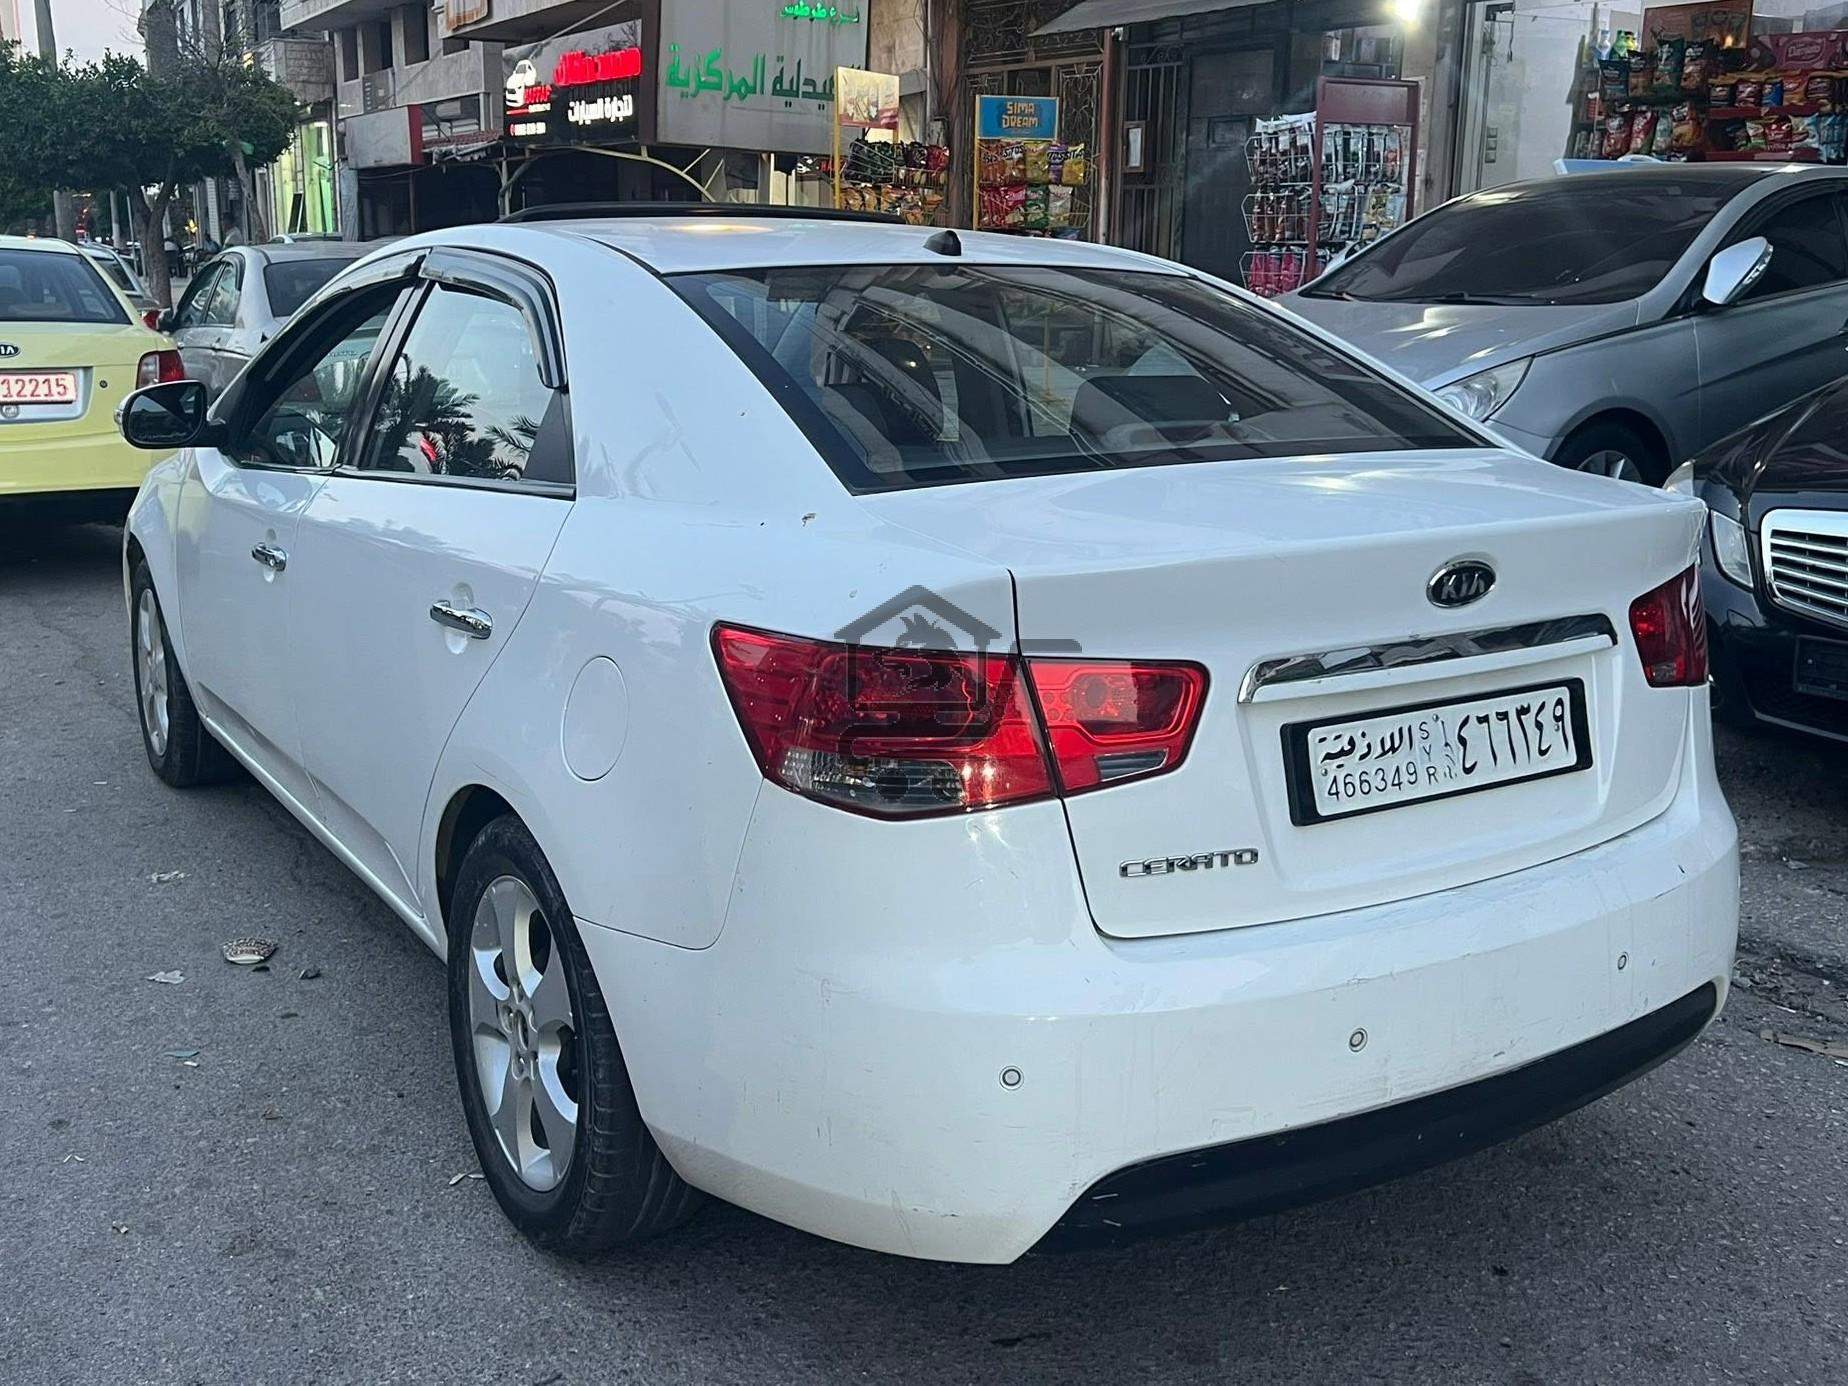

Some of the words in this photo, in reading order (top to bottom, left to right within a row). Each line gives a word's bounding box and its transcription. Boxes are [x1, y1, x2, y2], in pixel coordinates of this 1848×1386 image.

[665, 43, 766, 101] المركزية
[1002, 115, 1039, 129] DREAM
[1006, 101, 1035, 115] SIMA
[1, 378, 68, 398] 12215
[1440, 570, 1485, 600] KIA
[1457, 697, 1569, 775] ٤٦٦٣٤٩
[1327, 761, 1418, 801] 466349
[1119, 848, 1259, 877] CERATO
